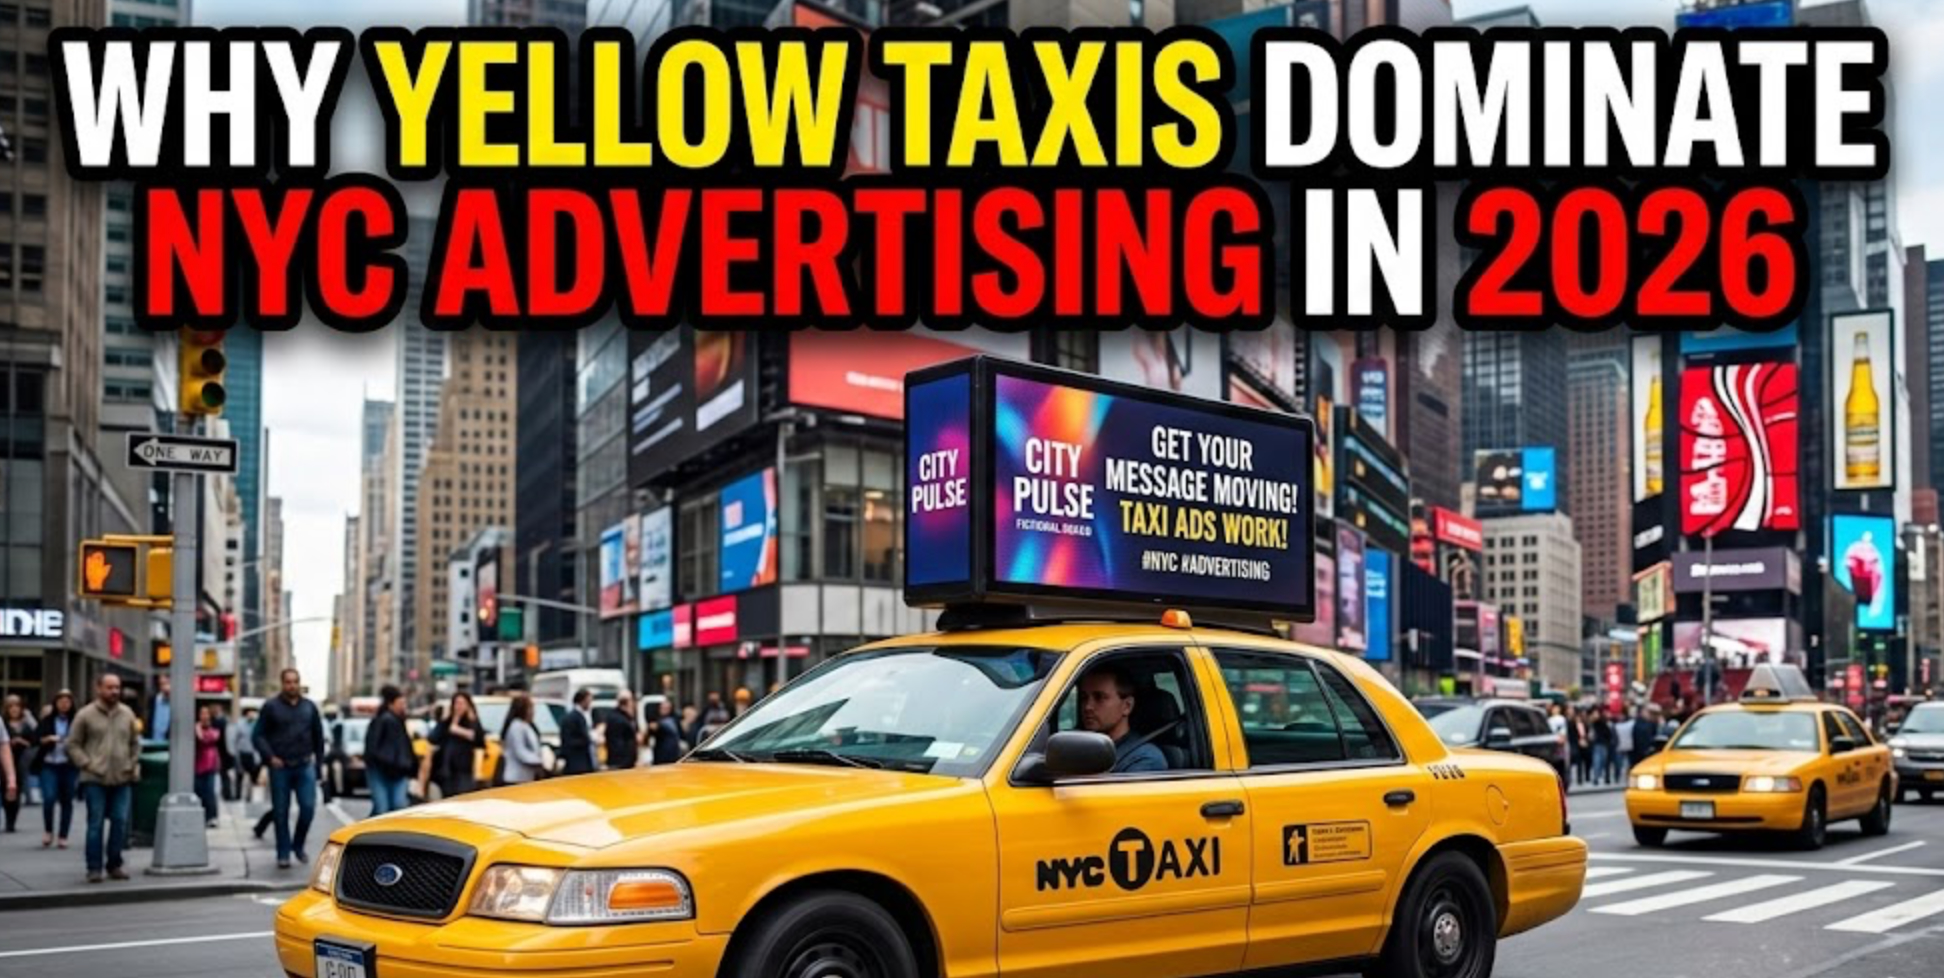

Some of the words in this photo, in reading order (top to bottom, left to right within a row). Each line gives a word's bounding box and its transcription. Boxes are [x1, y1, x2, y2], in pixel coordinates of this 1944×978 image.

[143, 444, 175, 460] ONE
[189, 447, 226, 463] WAY
[918, 449, 959, 482] CITY
[1024, 437, 1082, 478] CITY
[1152, 425, 1191, 463] GET
[1198, 433, 1253, 471] YOUR
[911, 478, 967, 513] PULSE
[1013, 476, 1095, 520] PULSE
[1105, 458, 1208, 503] MESSAGE
[1213, 475, 1298, 515] MOVING!
[1119, 500, 1170, 534] TAXI
[1174, 507, 1217, 543] ADS
[1223, 517, 1289, 550] WORK!
[1141, 550, 1179, 572] #NYC
[1036, 856, 1105, 891] NYC
